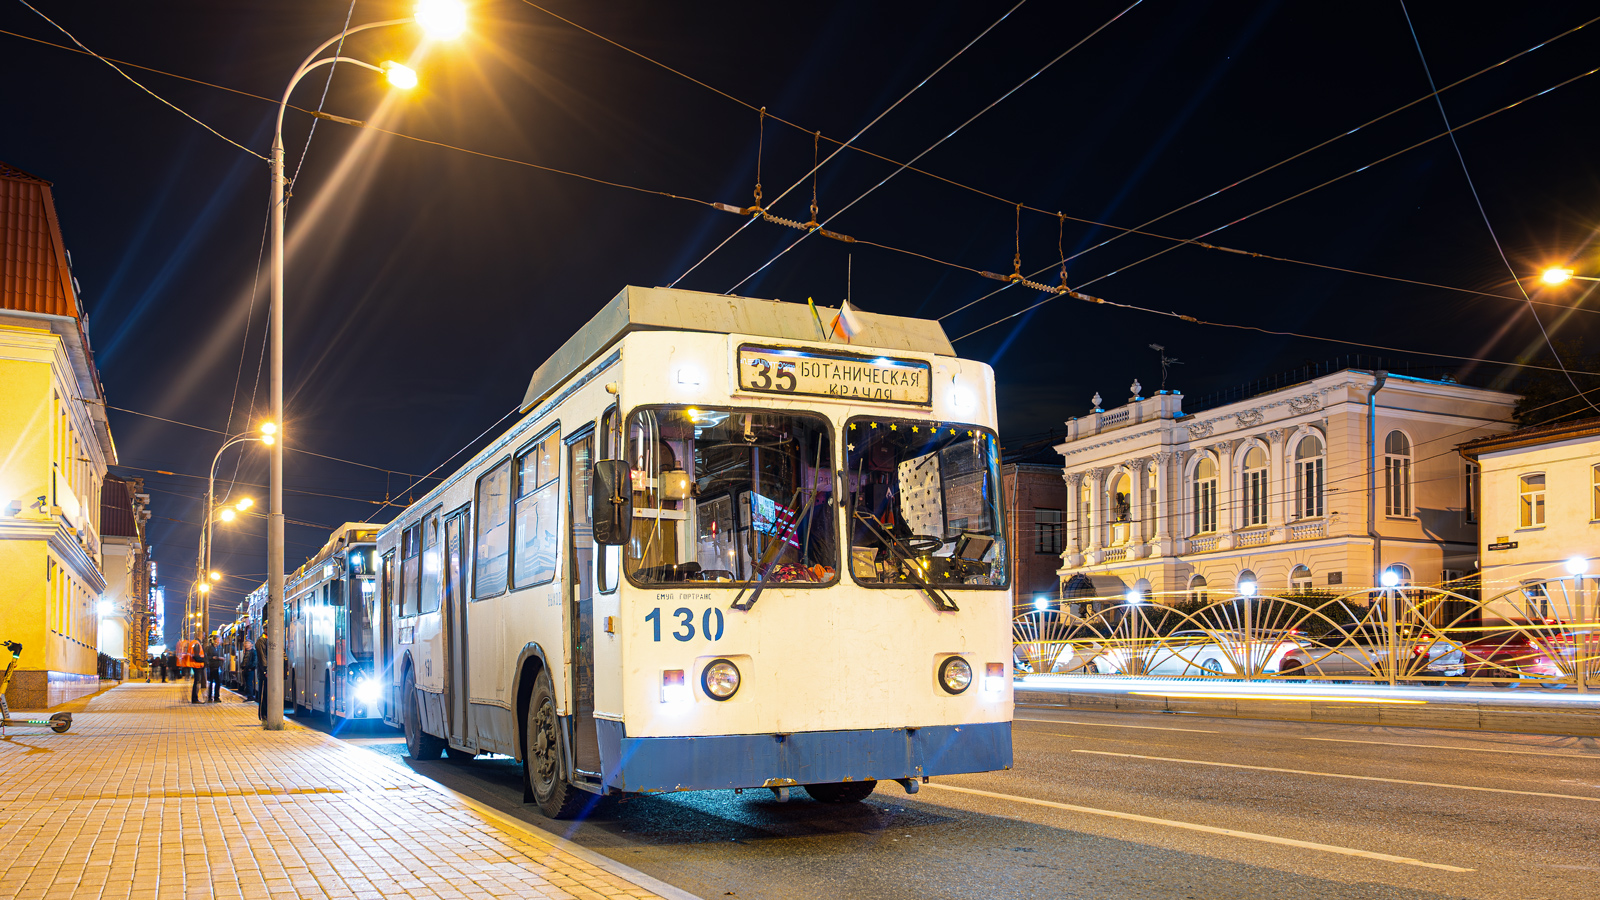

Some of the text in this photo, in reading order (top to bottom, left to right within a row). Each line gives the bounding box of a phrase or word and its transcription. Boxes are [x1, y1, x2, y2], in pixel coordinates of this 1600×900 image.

[751, 358, 797, 392] 35
[801, 361, 918, 387] БОТАНИЧЕСКАЯ
[656, 593, 712, 601] ЕМУП ГОРТРАНС
[644, 607, 725, 642] 130
